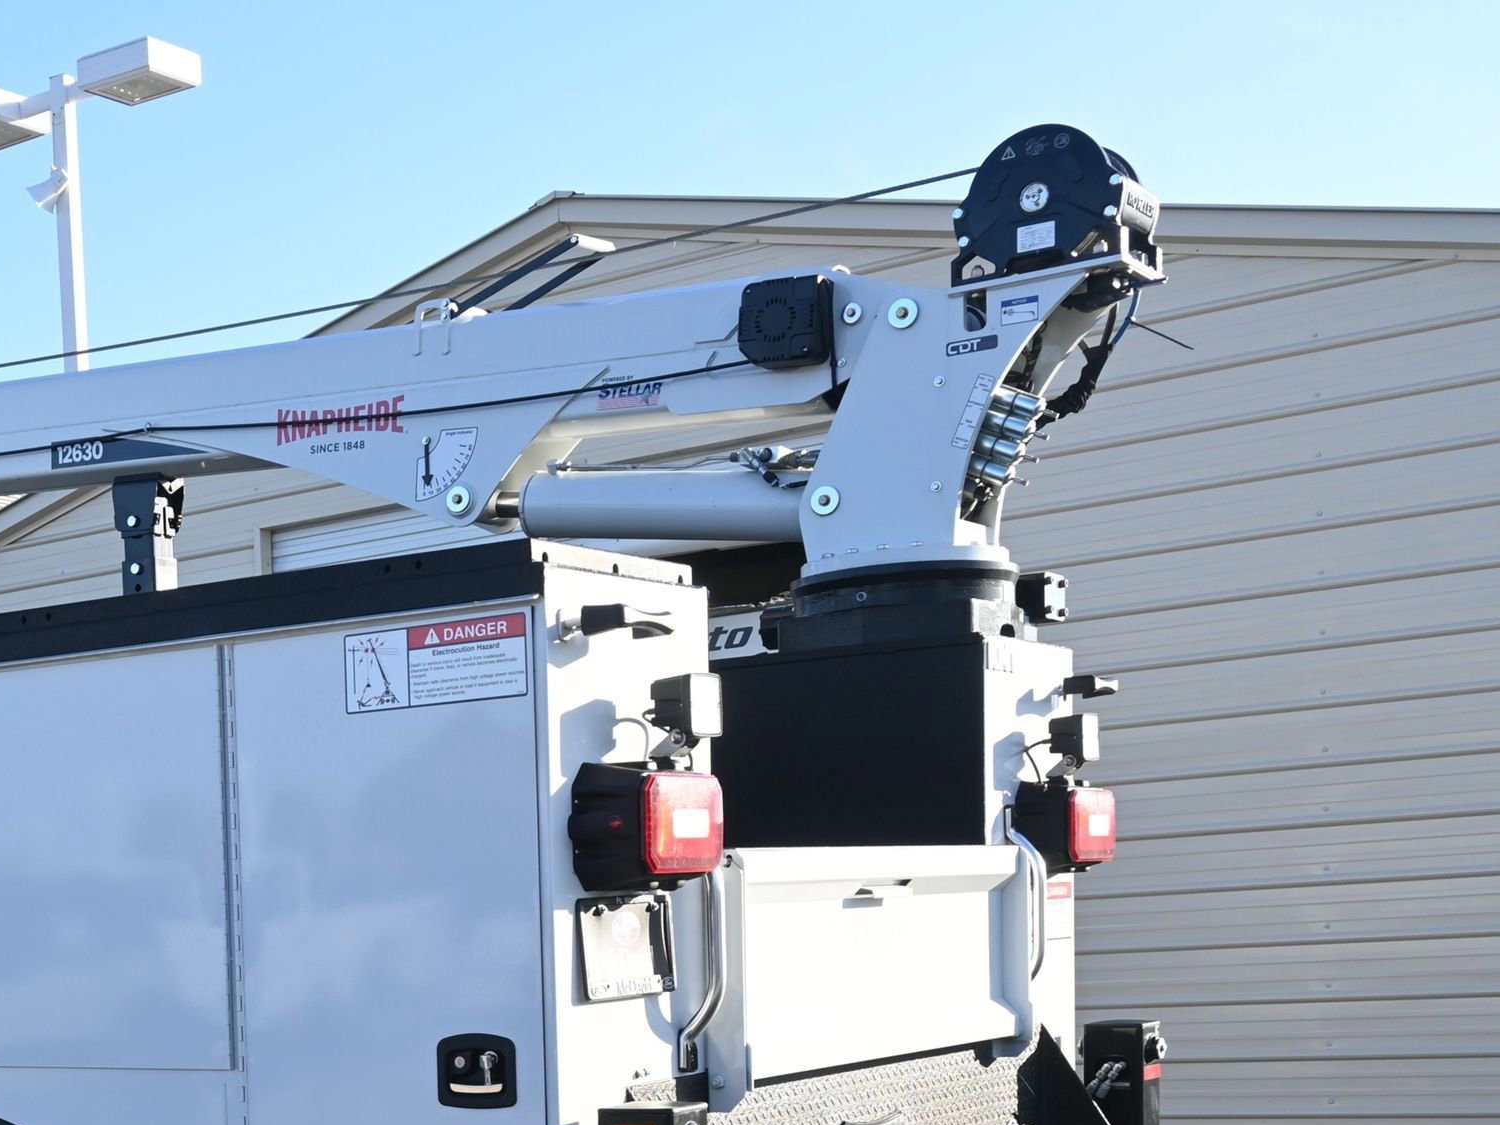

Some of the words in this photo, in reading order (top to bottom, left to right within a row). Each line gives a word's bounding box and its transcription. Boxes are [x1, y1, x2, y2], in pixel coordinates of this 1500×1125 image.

[948, 338, 981, 355] CDT
[598, 383, 662, 399] STELLAR
[277, 394, 404, 446] KNAPHEIDE
[57, 441, 103, 464] 12630
[310, 443, 339, 454] SINCE
[343, 440, 365, 451] 1848
[444, 621, 507, 641] DANGER
[432, 645, 475, 656] Electrocution
[477, 642, 500, 651] Hazard
